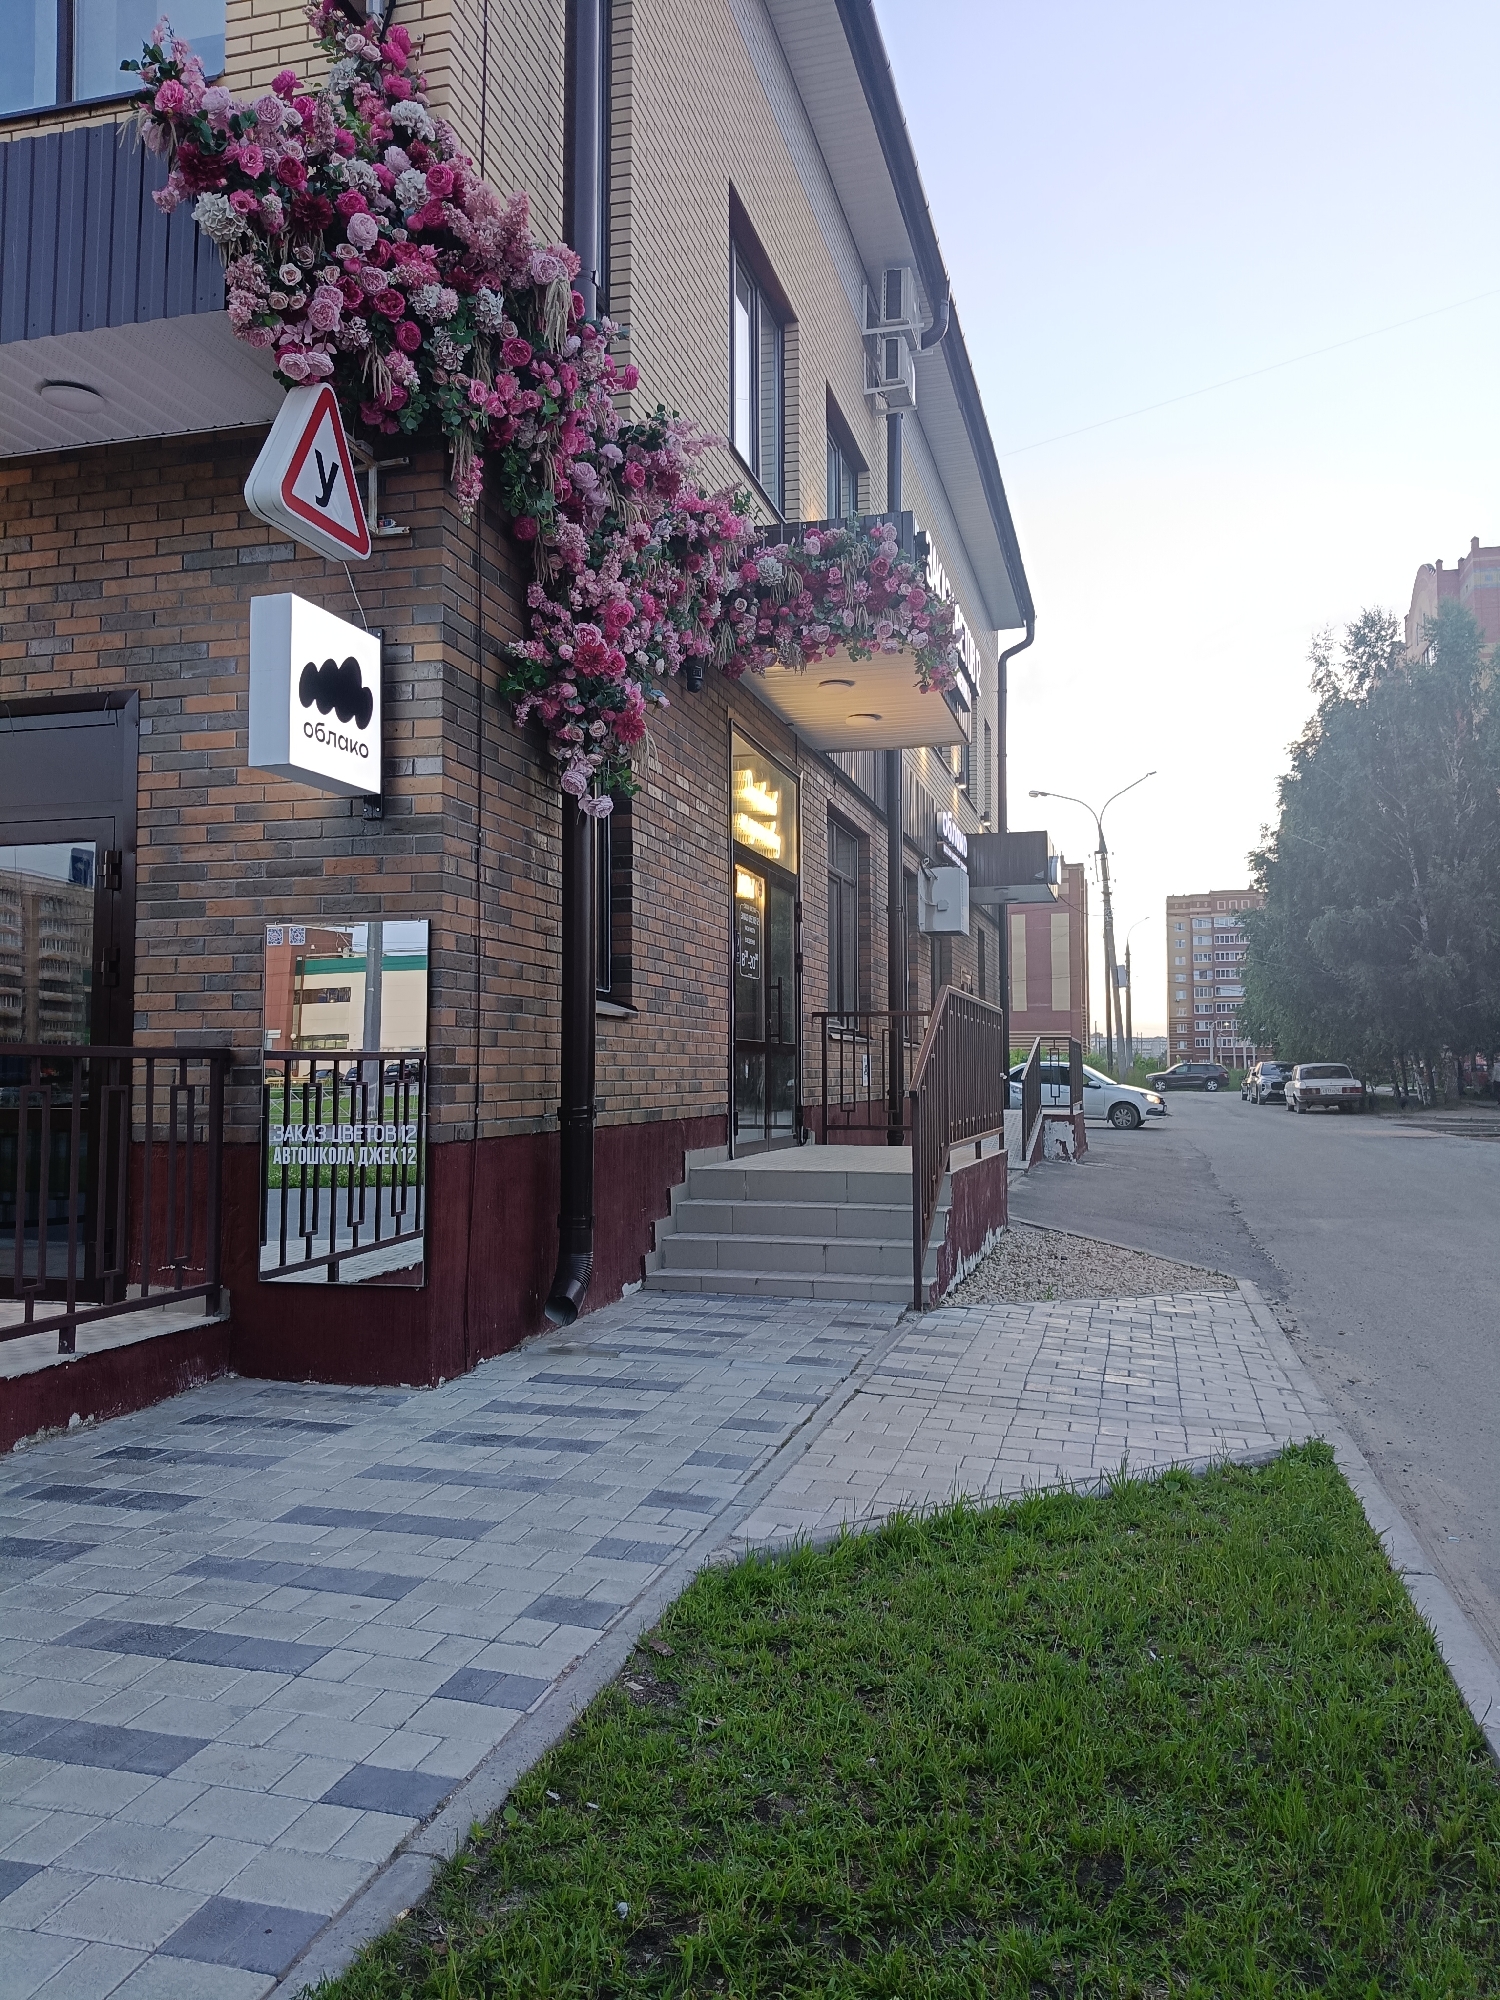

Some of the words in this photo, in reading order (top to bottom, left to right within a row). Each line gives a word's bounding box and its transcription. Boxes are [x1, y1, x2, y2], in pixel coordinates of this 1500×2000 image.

[303, 721, 369, 759] облако
[273, 1124, 327, 1142] ЗАКАЗ
[332, 1124, 397, 1144] ЦВЕТОВ
[400, 1124, 418, 1143] 12
[272, 1146, 355, 1165] АВТОШКОЛА
[357, 1146, 399, 1167] ДЖЕК
[400, 1146, 417, 1165] 12
